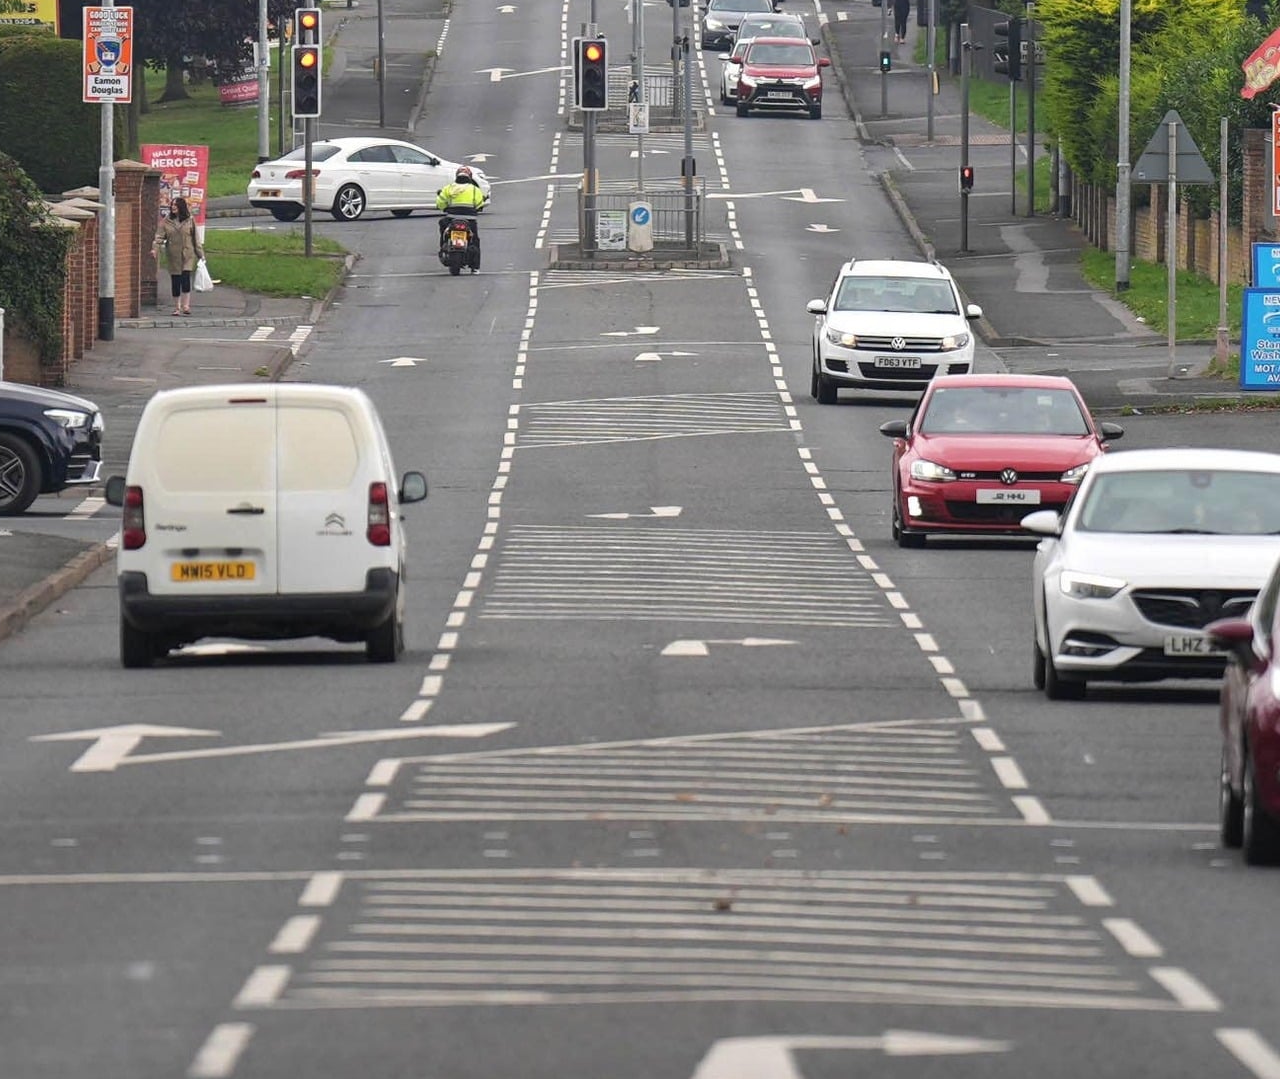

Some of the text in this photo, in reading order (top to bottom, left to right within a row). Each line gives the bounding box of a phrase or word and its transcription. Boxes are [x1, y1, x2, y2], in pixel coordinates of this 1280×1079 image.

[89, 10, 129, 20] GOOD LUCK
[94, 76, 121, 85] Eamon
[91, 86, 123, 95] Douglas
[152, 149, 196, 158] HALF PRICE
[151, 158, 198, 168] HEROES
[1252, 350, 1280, 360] Wash
[1255, 364, 1275, 373] MOT
[1171, 636, 1204, 653] LHZ
